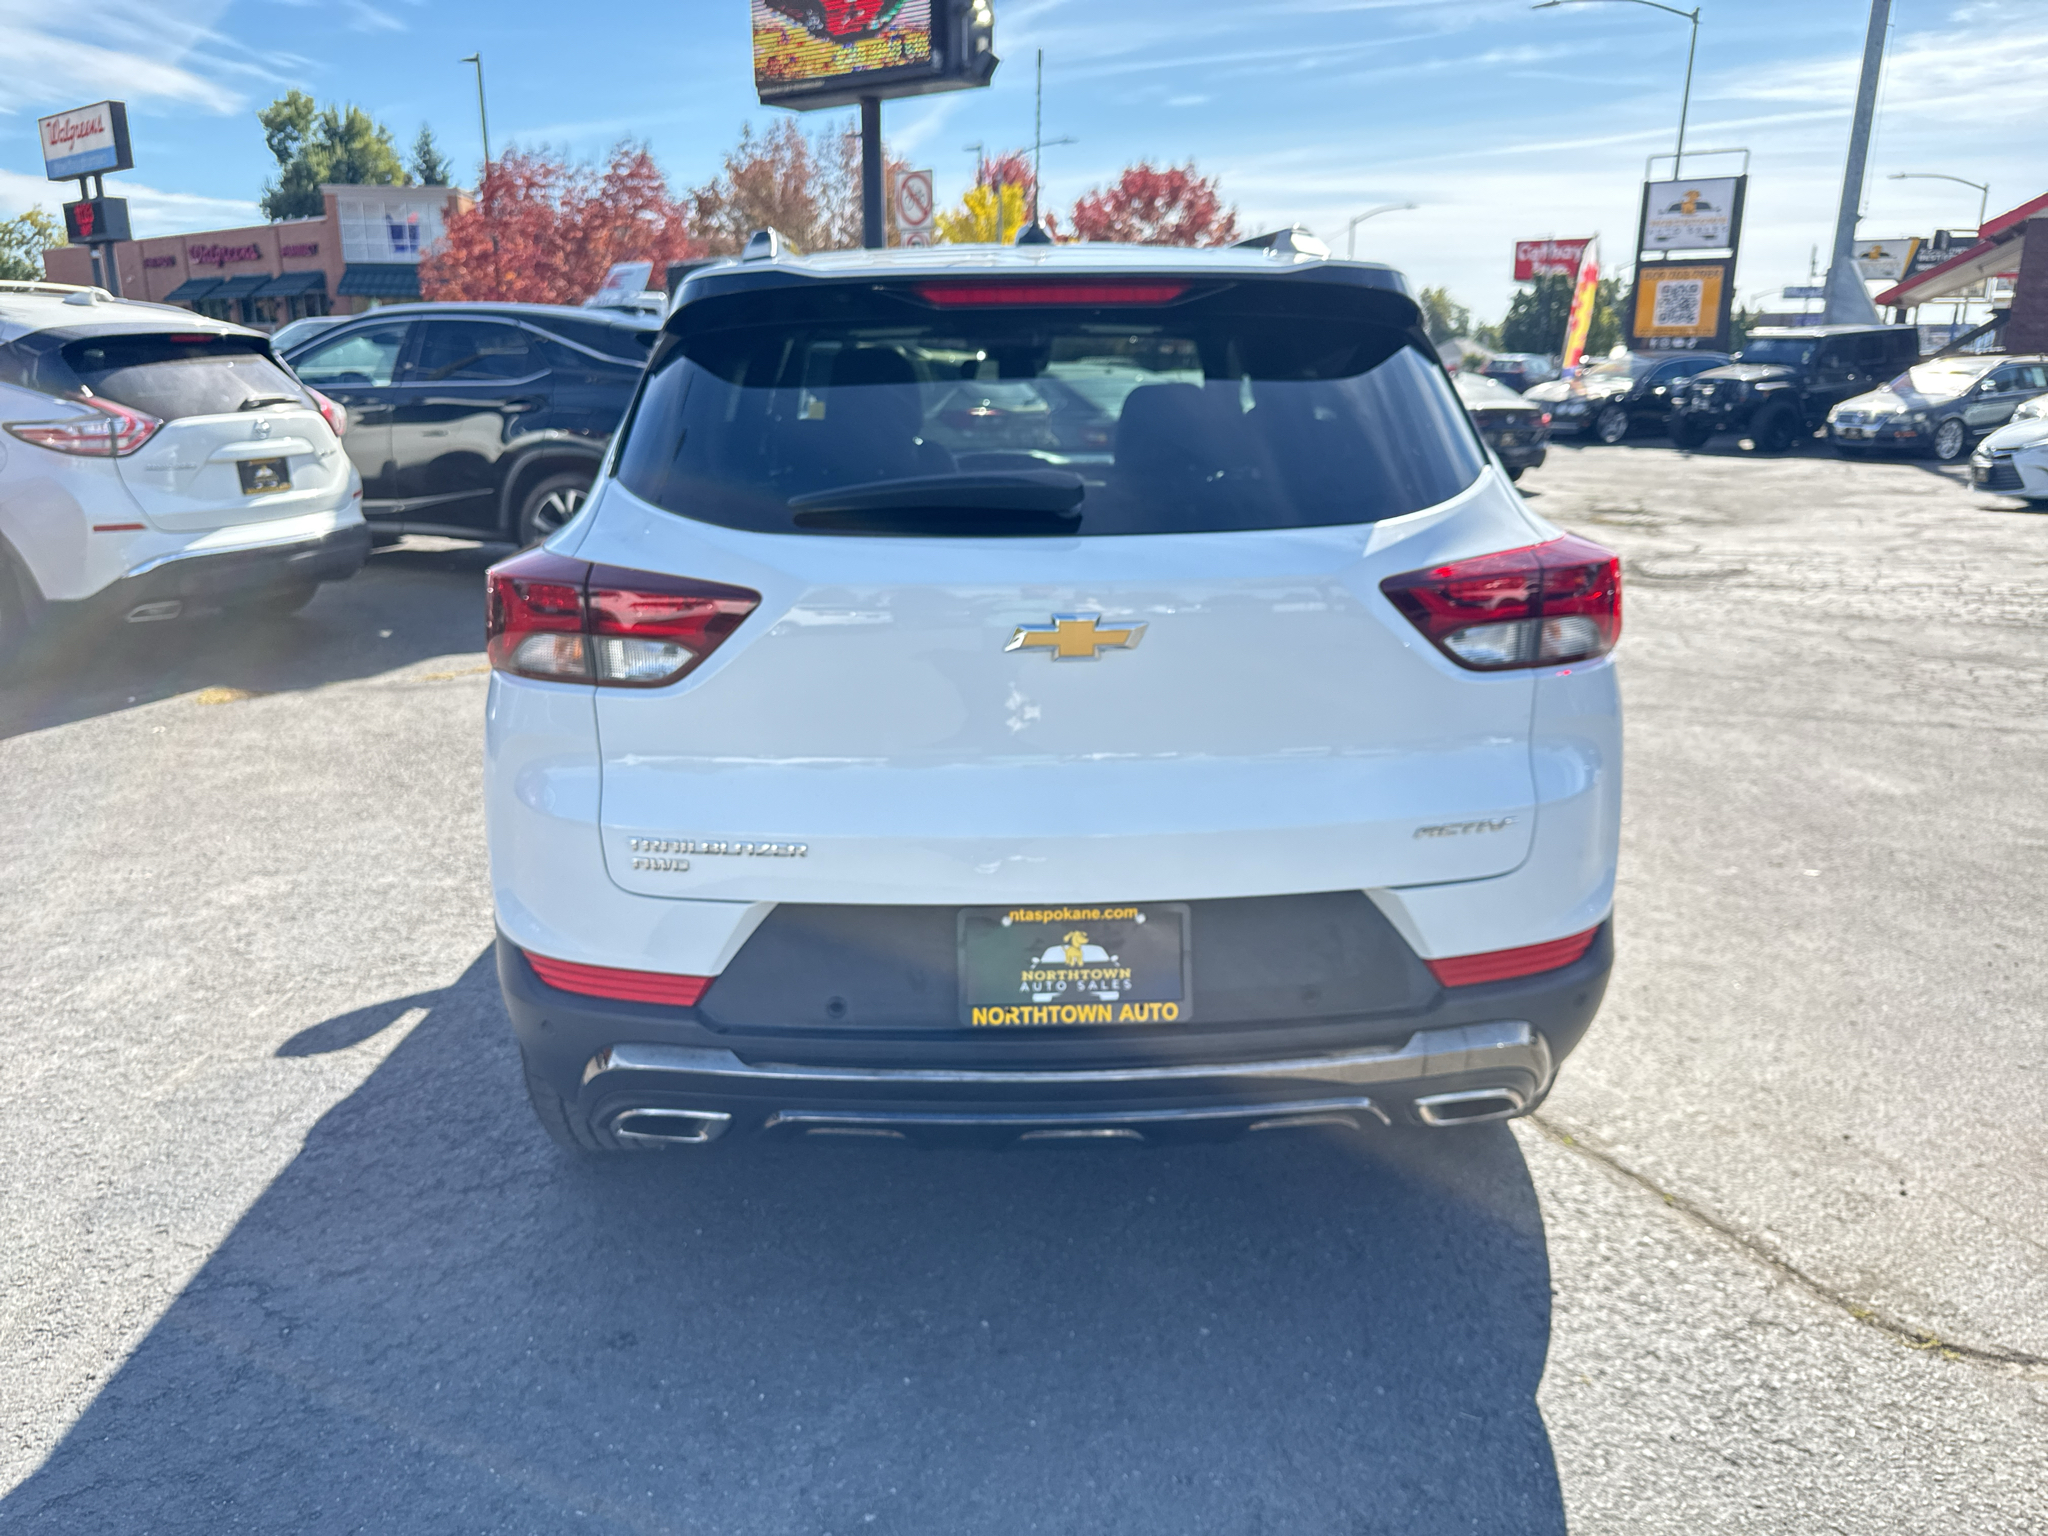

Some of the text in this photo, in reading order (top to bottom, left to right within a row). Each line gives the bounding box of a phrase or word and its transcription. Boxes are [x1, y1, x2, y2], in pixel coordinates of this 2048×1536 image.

[46, 114, 105, 151] Walgreens
[628, 836, 808, 857] TRAILBLAZER
[631, 856, 690, 872] AWD
[1009, 907, 1139, 924] ntaspokane.com
[1021, 968, 1132, 982] NORTHTOWN
[1019, 979, 1132, 993] AUTO SALES
[972, 1002, 1179, 1026] NORTHTOWN AUTO
